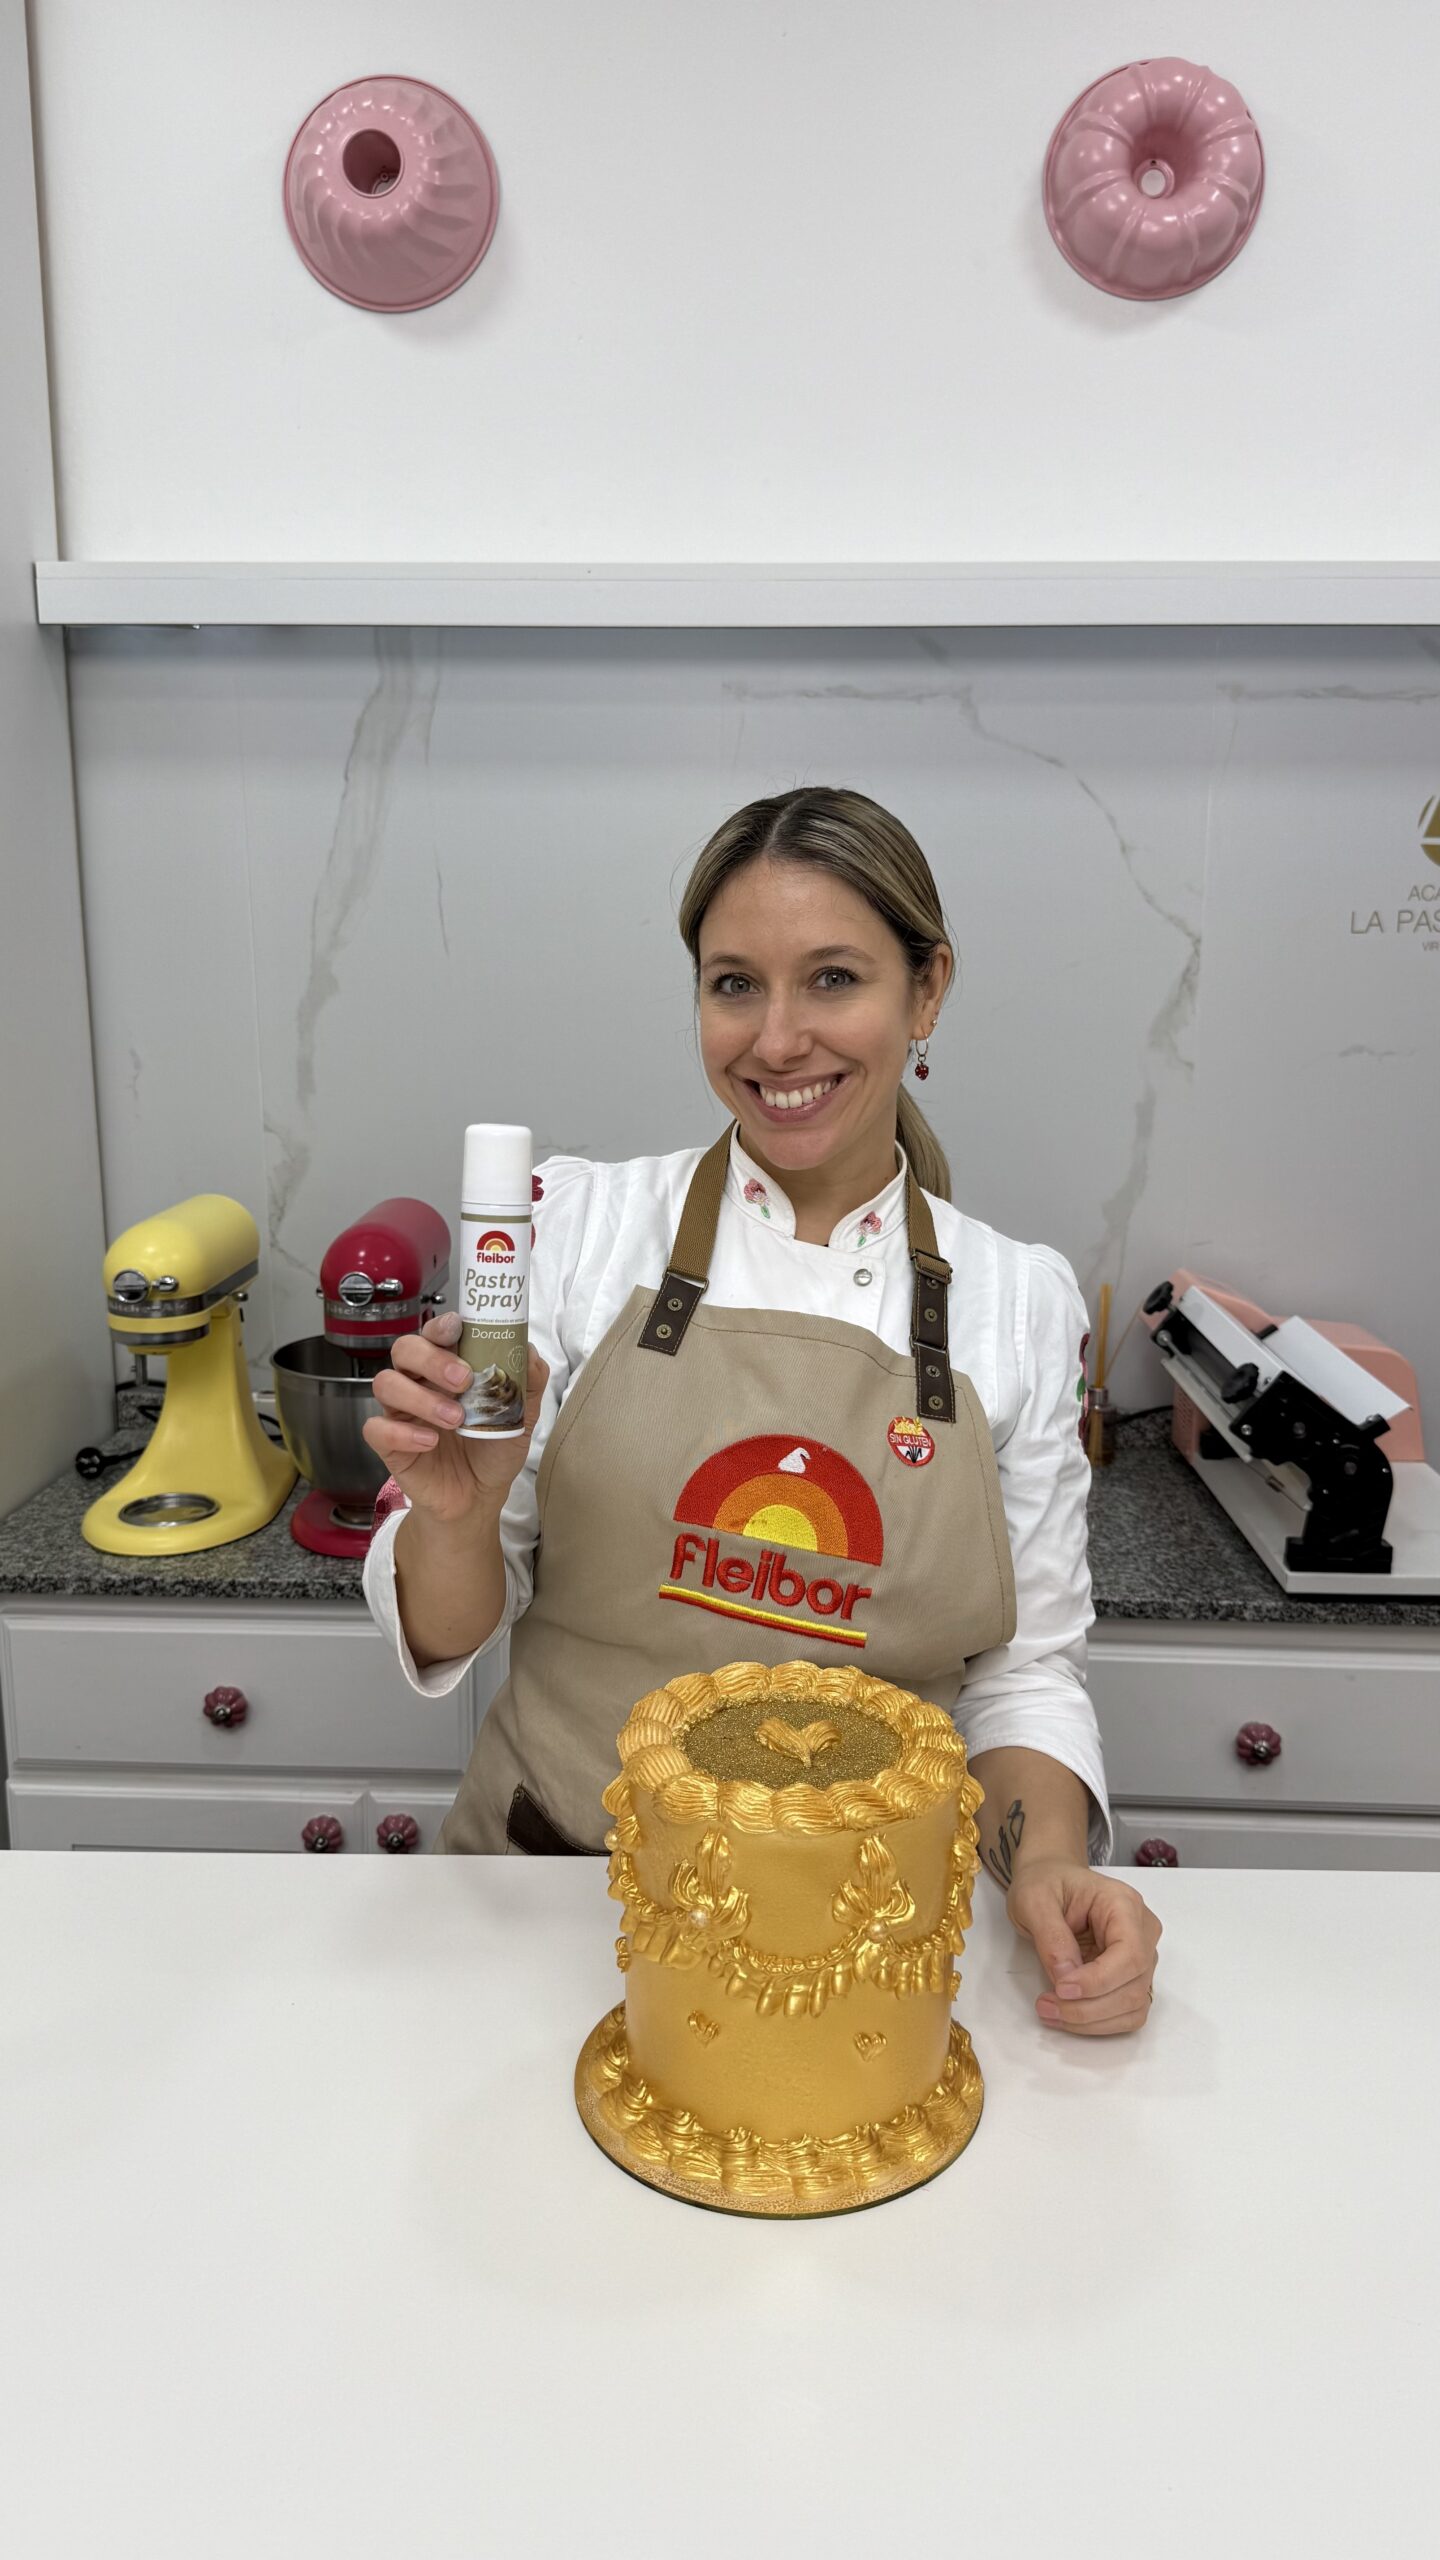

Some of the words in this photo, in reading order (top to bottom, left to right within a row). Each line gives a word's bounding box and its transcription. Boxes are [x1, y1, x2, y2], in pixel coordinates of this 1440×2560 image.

[1350, 910, 1384, 935] LA
[476, 1252, 516, 1264] fleibor
[465, 1268, 526, 1293] Pastry
[466, 1287, 523, 1313] Spray
[471, 1327, 516, 1340] Dorado
[889, 1433, 902, 1443] SIN
[902, 1435, 932, 1447] GLUTEN
[669, 1532, 872, 1620] fleibor
